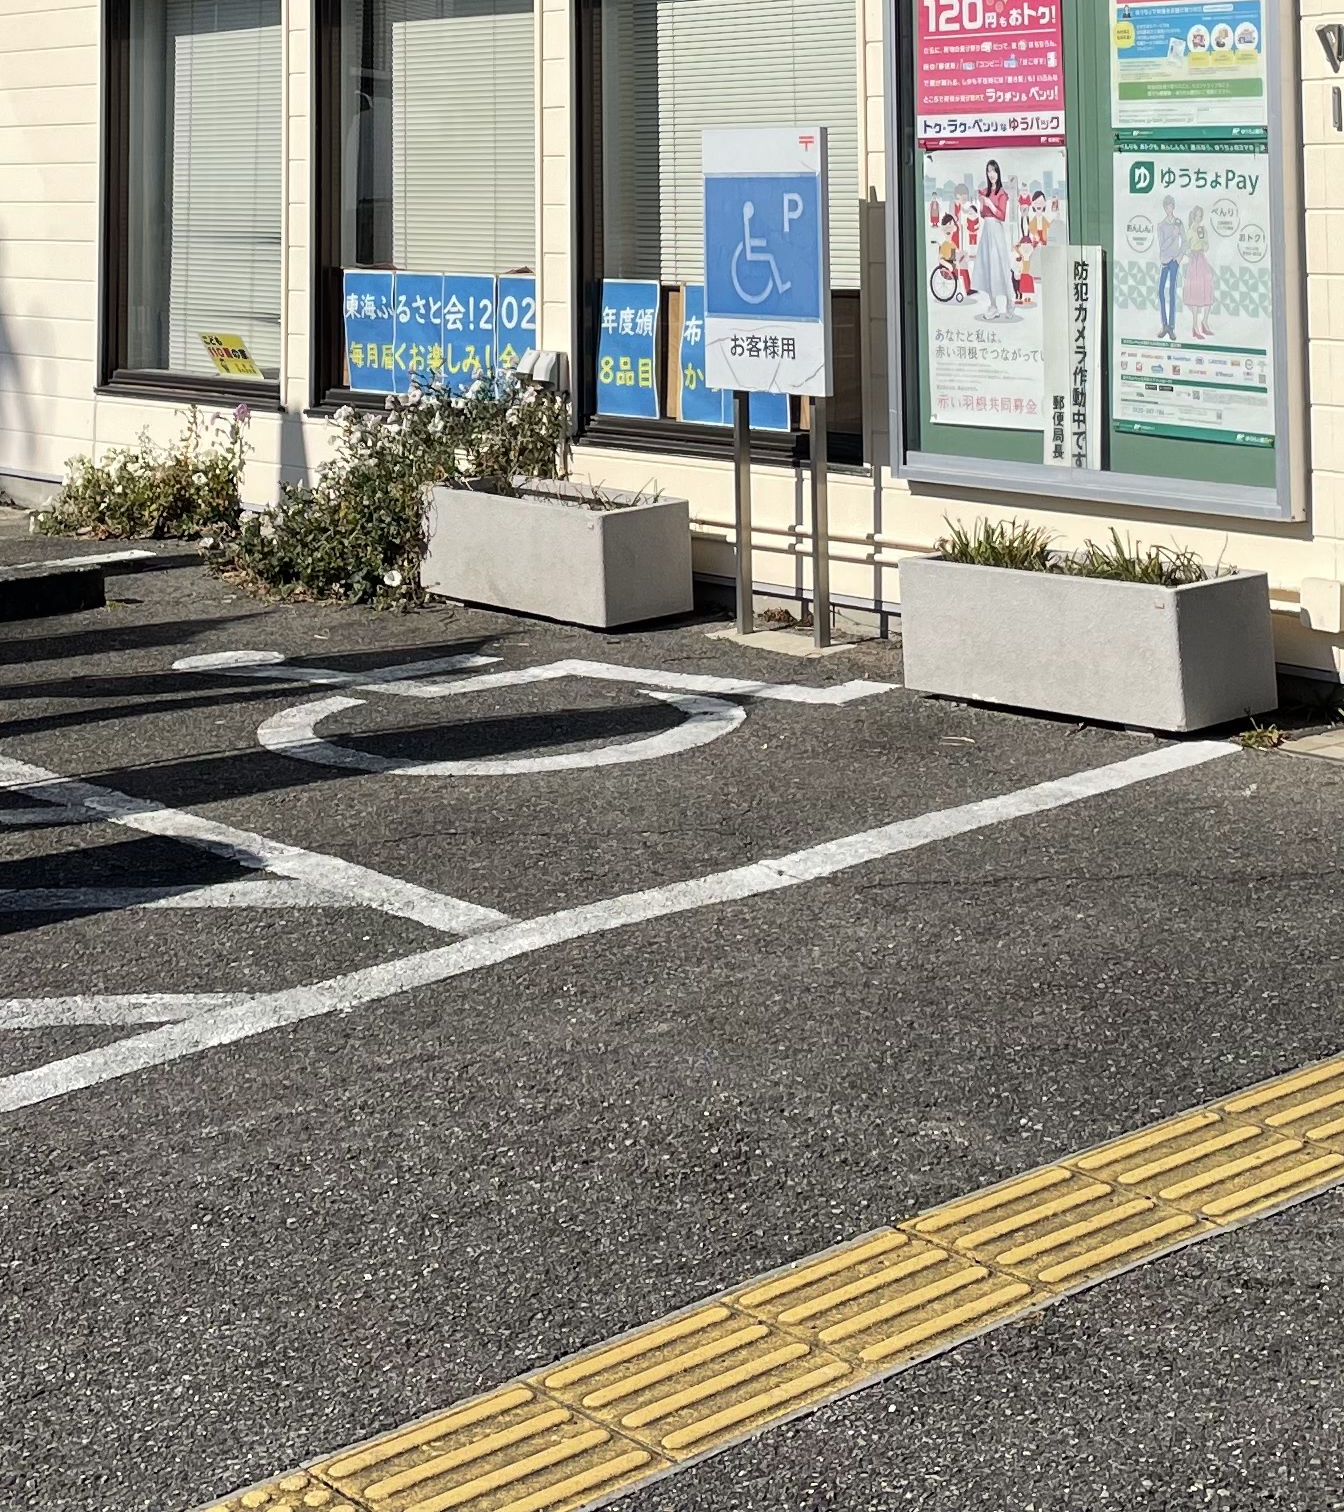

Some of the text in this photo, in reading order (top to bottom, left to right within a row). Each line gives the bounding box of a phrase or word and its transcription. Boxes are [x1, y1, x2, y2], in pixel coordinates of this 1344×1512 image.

[1160, 167, 1260, 195] ゆうちょPay
[783, 192, 804, 232] P
[730, 334, 797, 360] お客様用
[1072, 261, 1090, 468] 防犯カメラ作動中です
[600, 355, 654, 388] 8品目
[1052, 395, 1065, 460] 郵便局長
